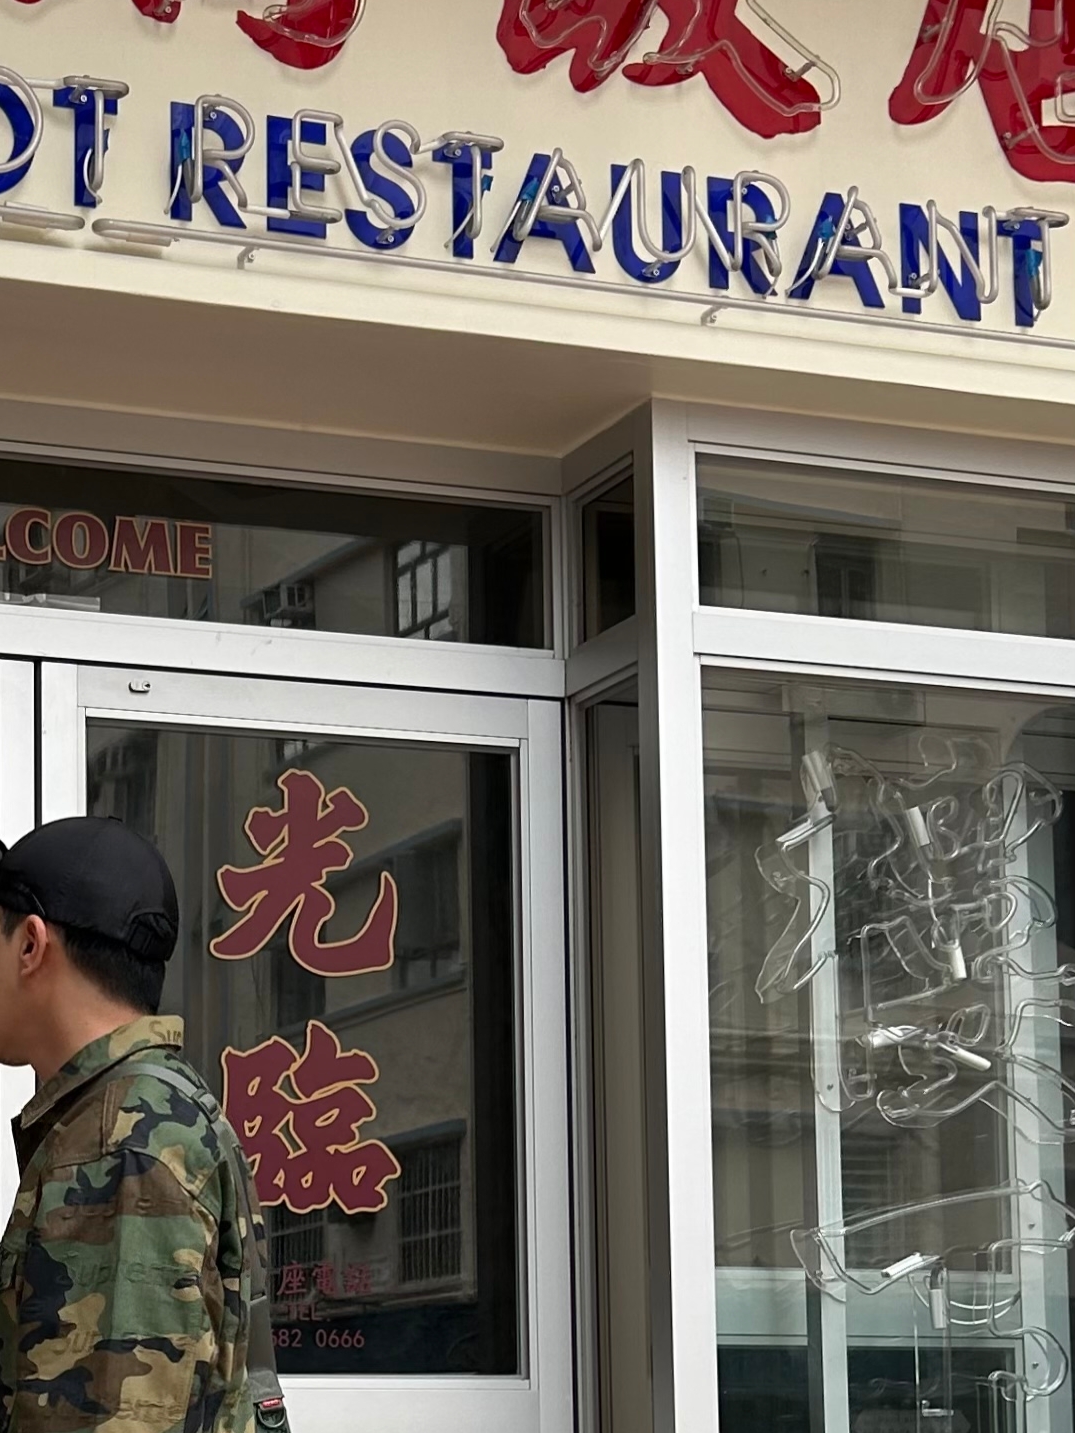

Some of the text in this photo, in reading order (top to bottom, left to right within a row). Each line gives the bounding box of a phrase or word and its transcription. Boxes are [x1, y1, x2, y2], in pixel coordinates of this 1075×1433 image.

[169, 94, 1070, 327] RESTAURANT
[209, 767, 402, 1214] 光臨
[314, 1328, 366, 1349] 0666
